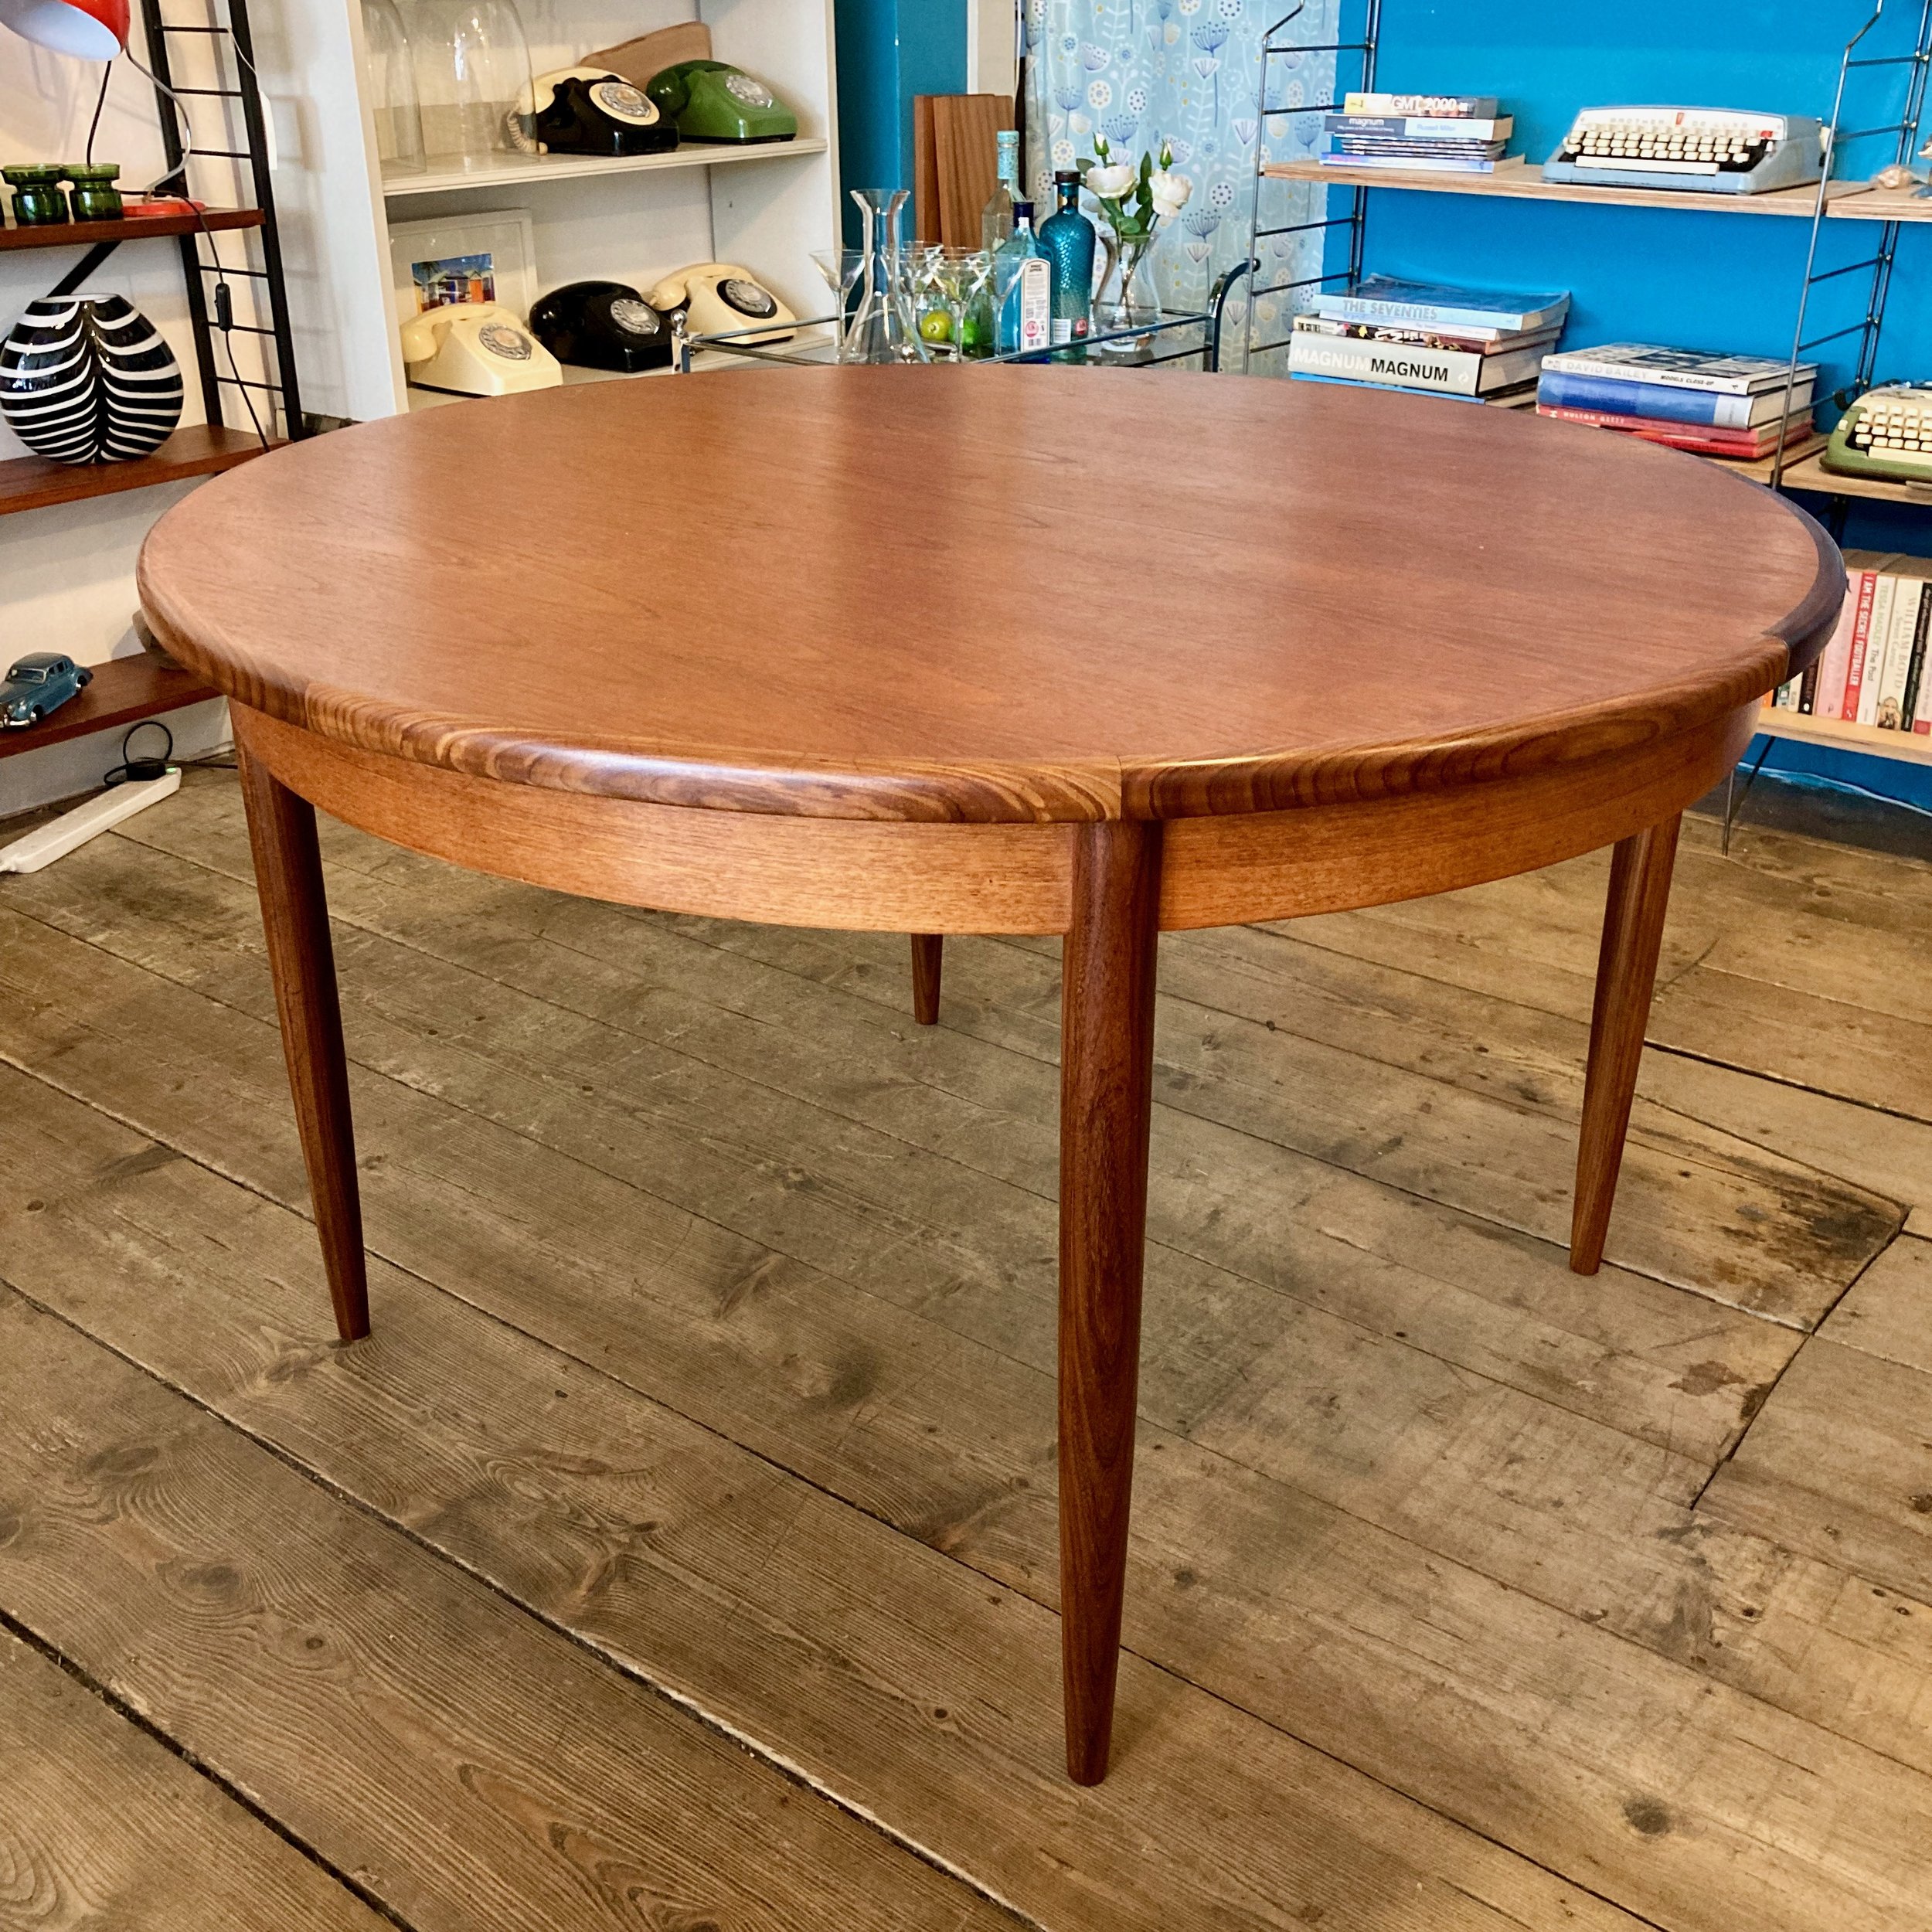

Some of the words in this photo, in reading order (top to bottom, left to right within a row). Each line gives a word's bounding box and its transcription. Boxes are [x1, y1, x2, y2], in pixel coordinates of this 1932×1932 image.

[1424, 97, 1458, 112] 2000
[1349, 117, 1385, 127] magnum
[1343, 299, 1366, 313] THE
[1370, 301, 1438, 320] SEVENTIES
[1293, 348, 1371, 372] MAGNUM
[1371, 359, 1449, 382] MAGNUM
[1566, 361, 1603, 375] DAVID
[1606, 364, 1648, 379] BAILEY
[1855, 610, 1869, 638] SECRET
[1900, 597, 1917, 650] WILLIAM
[1849, 639, 1865, 686] FOOTBALLER
[1869, 649, 1879, 664] The
[1894, 654, 1909, 689] BOYD
